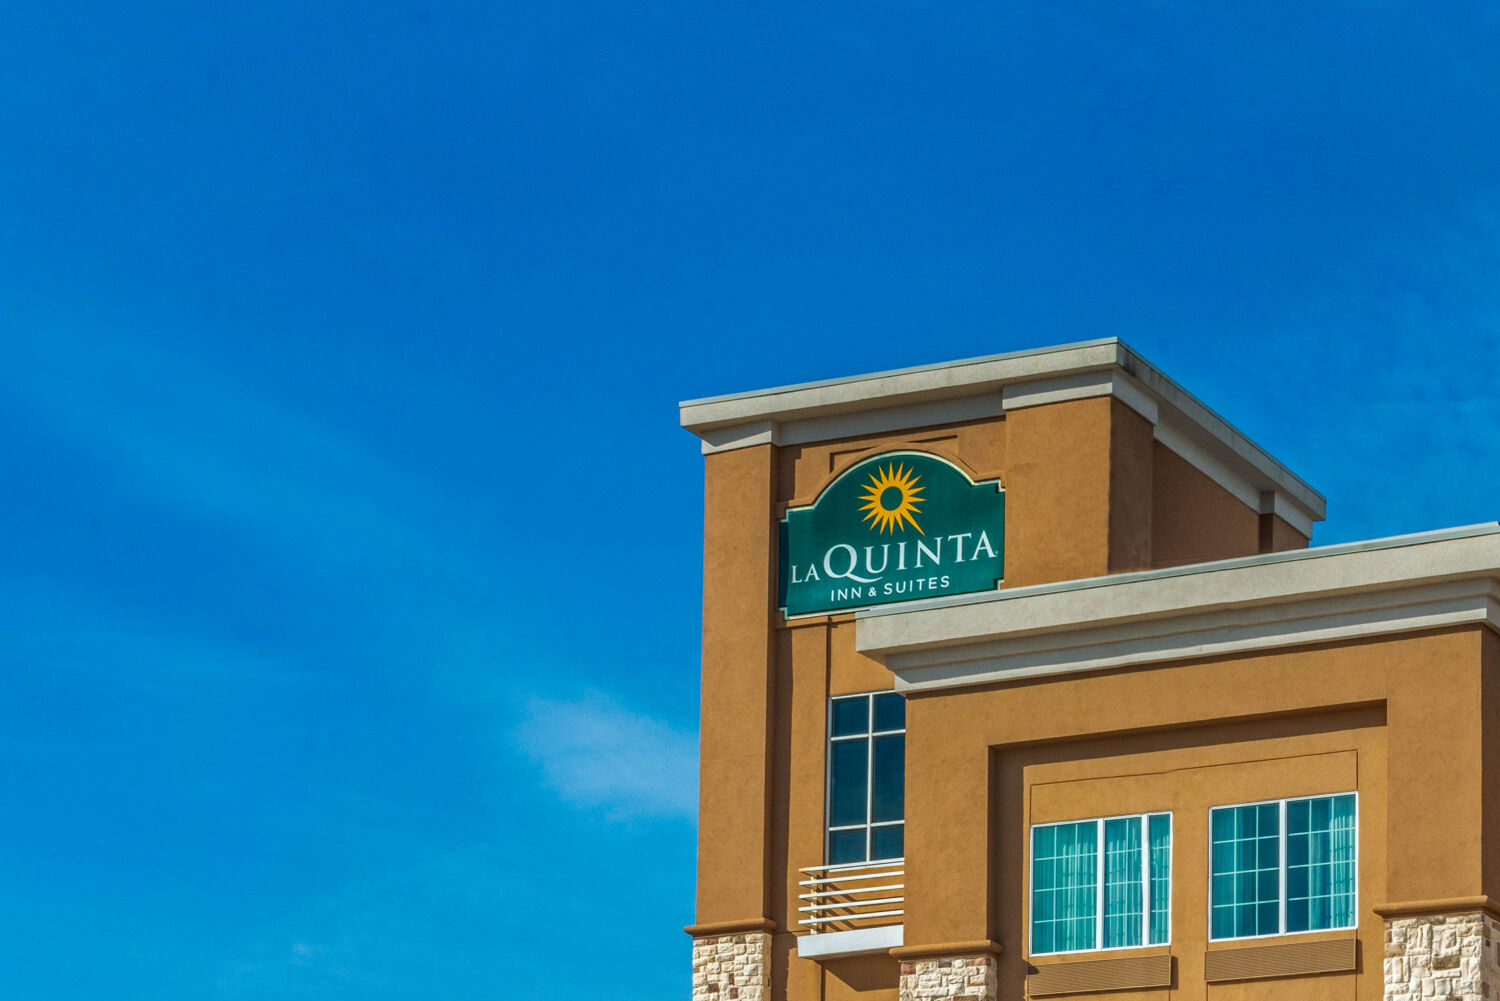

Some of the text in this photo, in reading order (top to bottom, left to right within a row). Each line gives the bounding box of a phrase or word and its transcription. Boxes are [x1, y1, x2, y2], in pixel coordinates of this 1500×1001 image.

[791, 530, 996, 583] LA QUINTA
[831, 576, 950, 601] INN & SUITES
